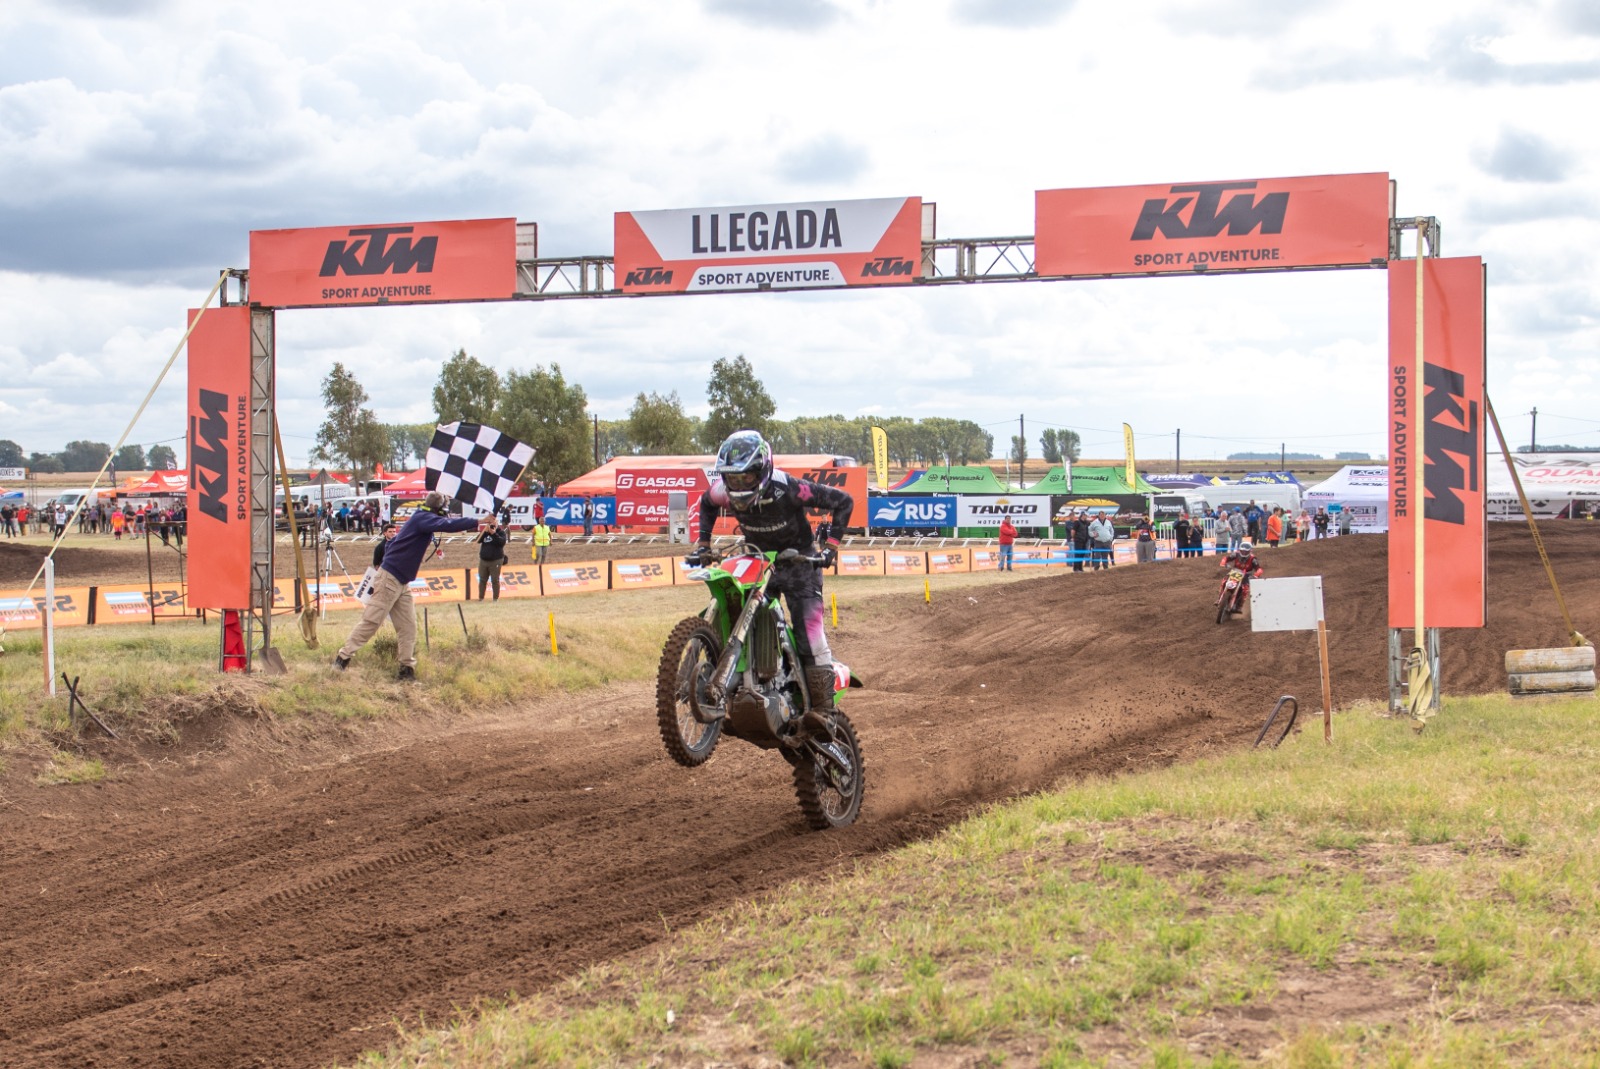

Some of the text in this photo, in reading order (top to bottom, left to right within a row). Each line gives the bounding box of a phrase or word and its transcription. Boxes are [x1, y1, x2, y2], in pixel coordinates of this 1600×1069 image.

[1129, 181, 1290, 241] KTM
[691, 208, 842, 254] LLEGADA
[318, 226, 439, 277] KTM
[1134, 248, 1280, 266] SPORT ADVENTURE
[624, 267, 674, 286] KTM
[860, 257, 914, 277] KTM
[698, 269, 830, 286] SPORT ADVENTURE
[322, 285, 432, 299] SPORT ADVENTURE
[1394, 366, 1407, 518] SPORT ADVENTURE
[1423, 361, 1478, 526] KTM
[190, 388, 229, 524] KTM
[237, 395, 246, 520] SPORT ADVENTURE
[636, 477, 696, 487] GASGAS
[801, 469, 848, 487] KTM
[1525, 468, 1600, 477] QUA
[637, 505, 669, 515] GAS
[905, 503, 947, 520] RUS
[732, 559, 754, 578] 1
